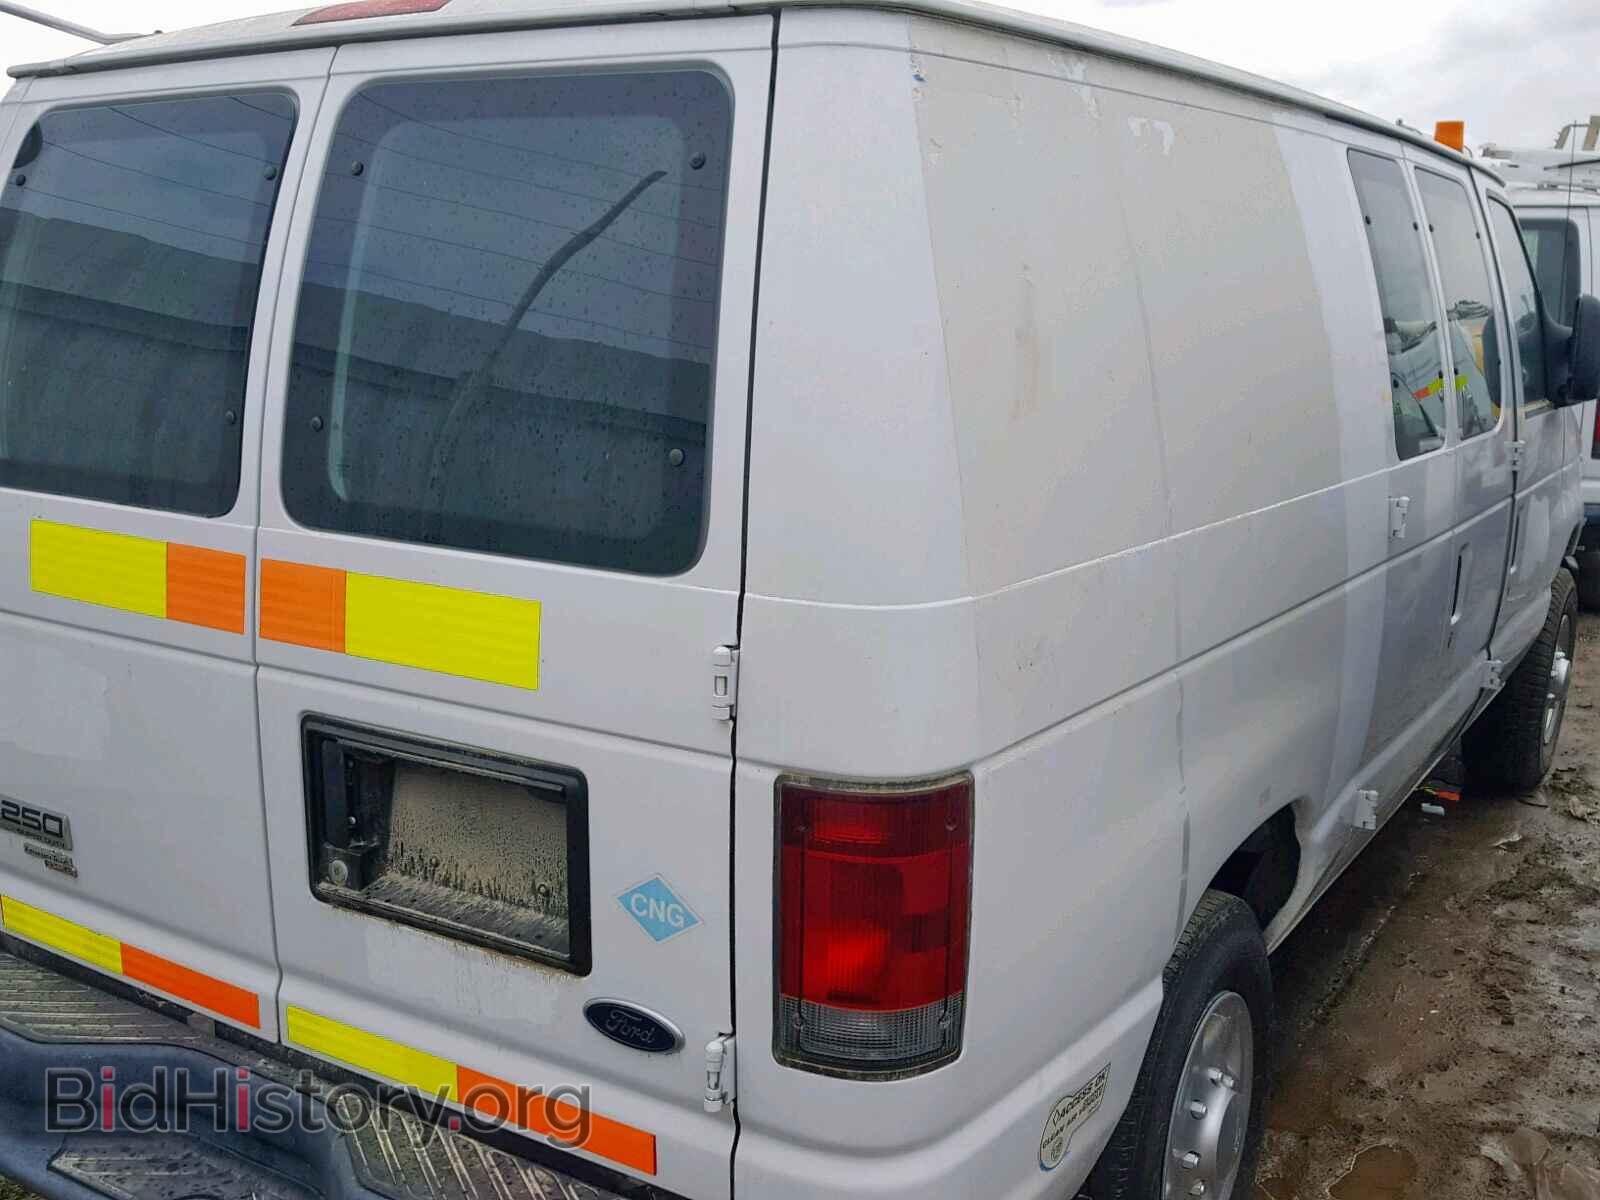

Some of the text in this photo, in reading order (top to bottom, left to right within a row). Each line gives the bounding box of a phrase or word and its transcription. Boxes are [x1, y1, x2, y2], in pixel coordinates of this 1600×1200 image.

[1, 800, 63, 838] 250
[630, 893, 684, 928] CNG
[605, 1009, 655, 1043] Ford
